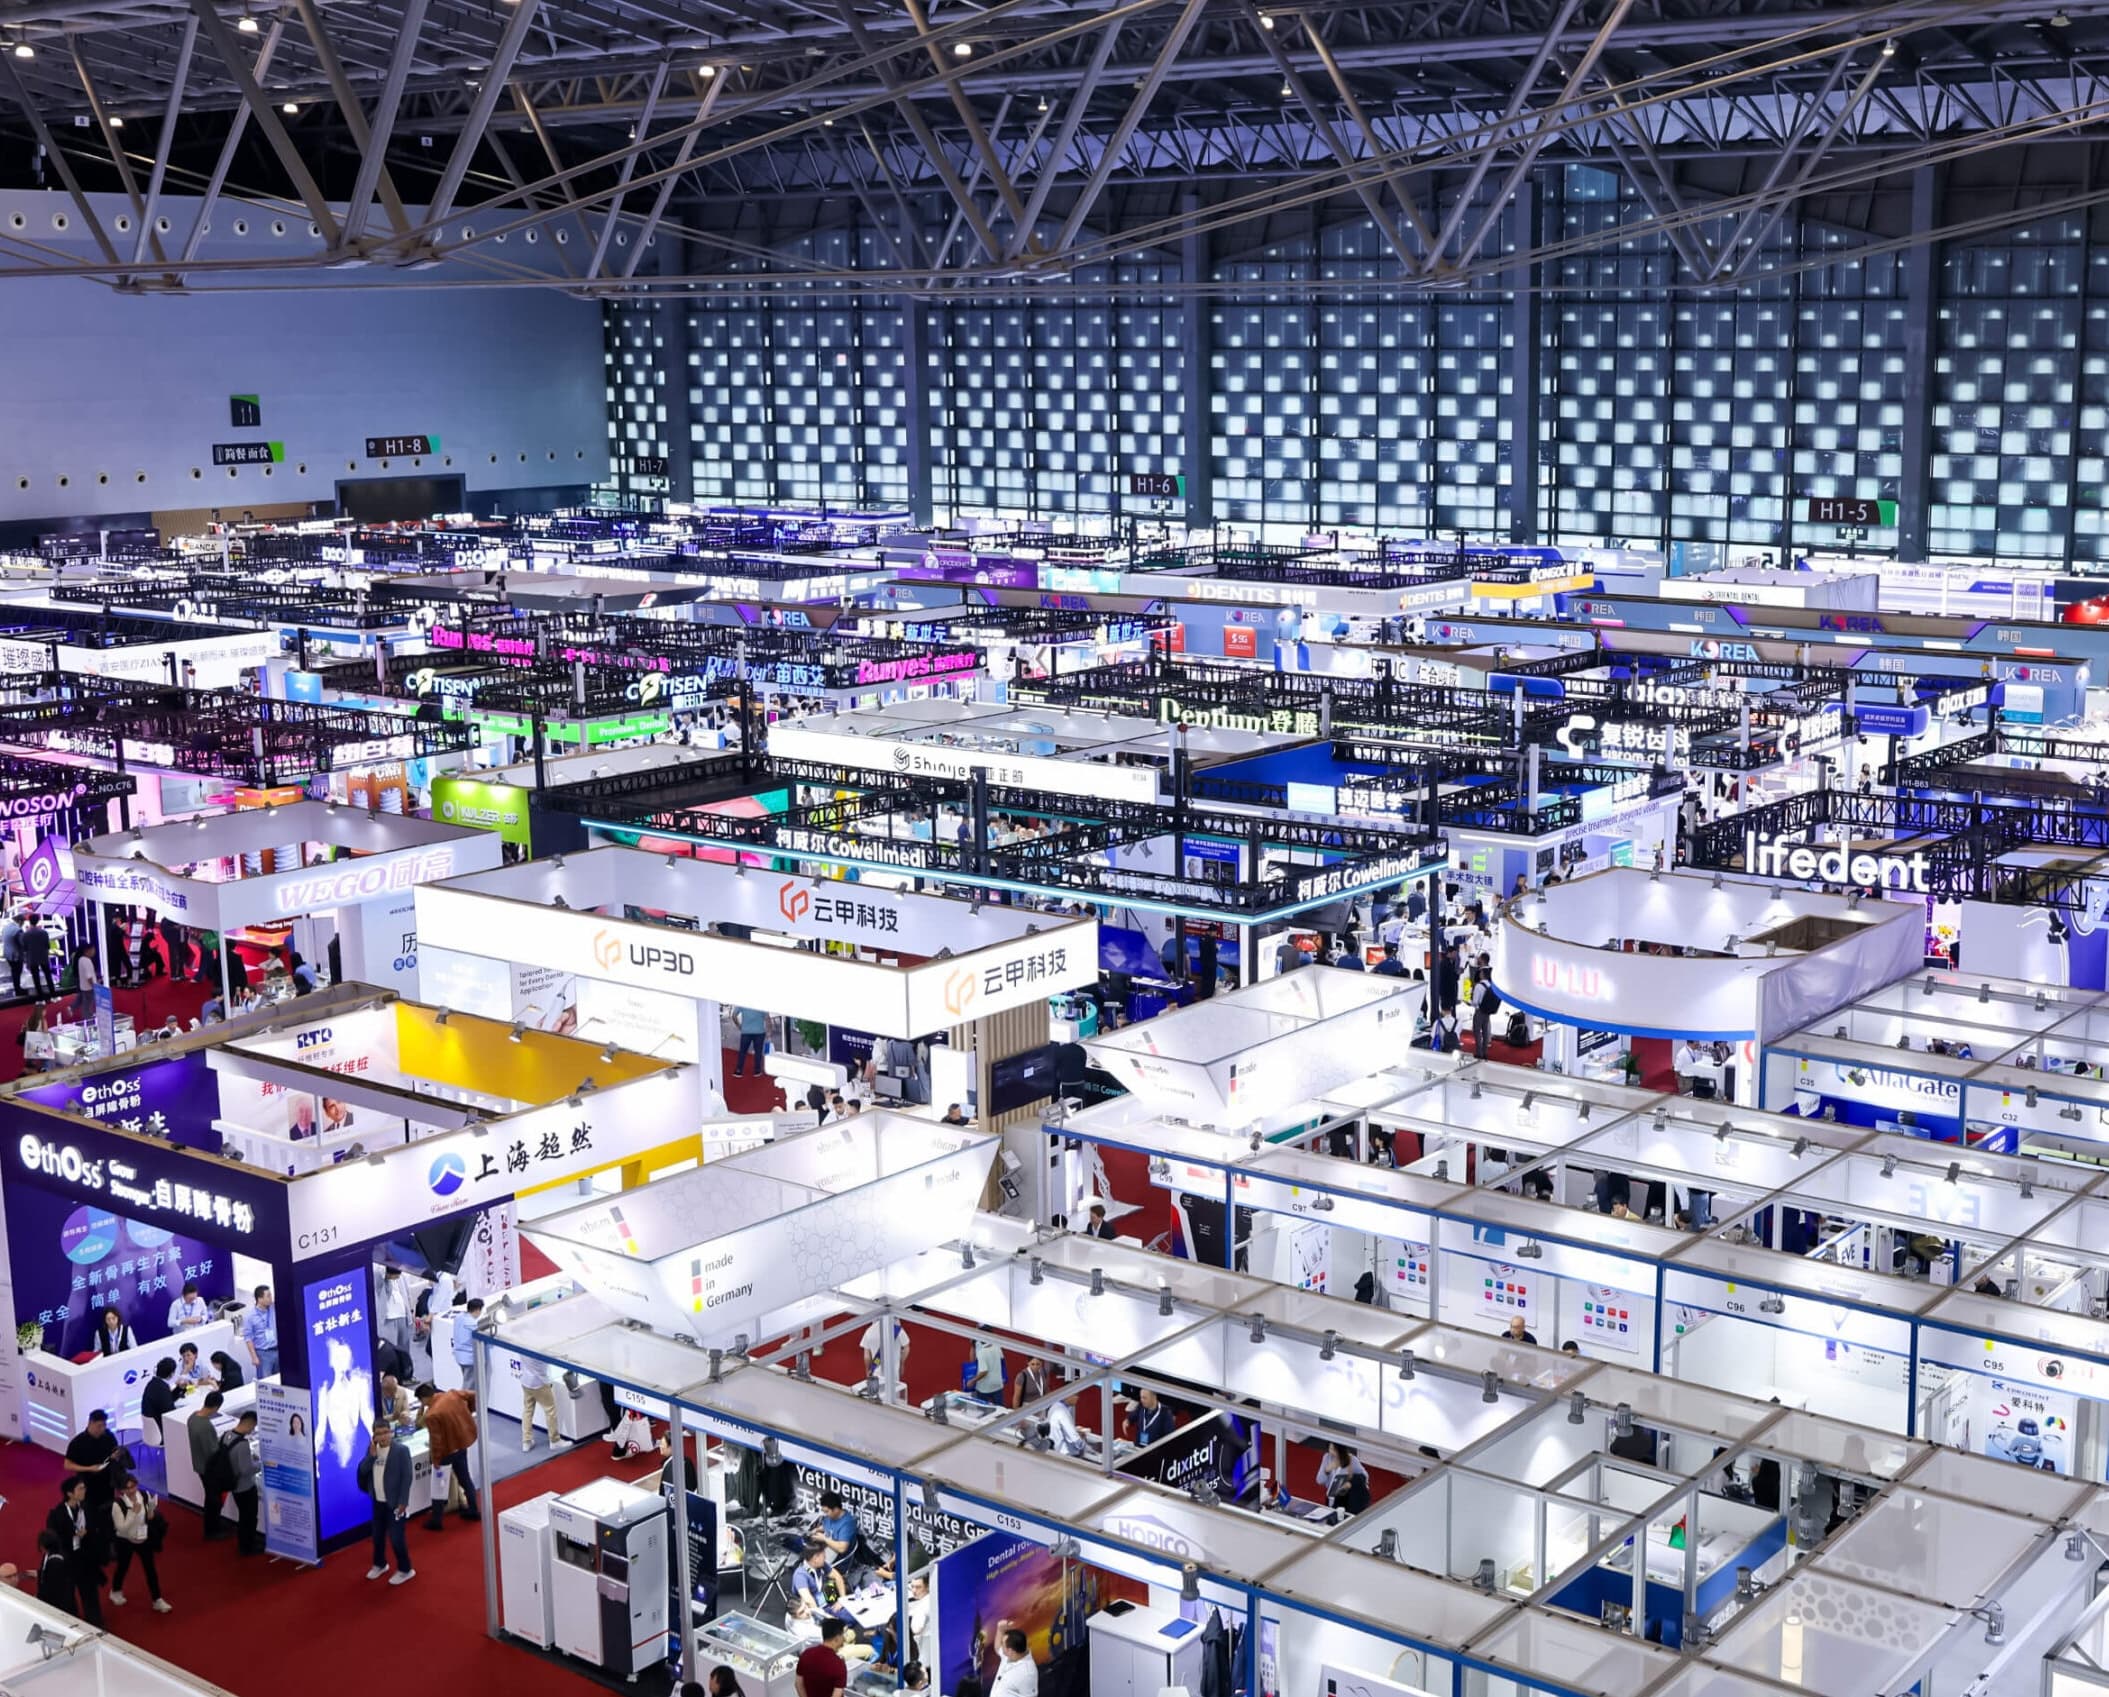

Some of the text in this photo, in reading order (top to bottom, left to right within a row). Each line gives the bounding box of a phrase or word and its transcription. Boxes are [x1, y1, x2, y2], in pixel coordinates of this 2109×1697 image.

[385, 437, 422, 455] H1-8
[639, 460, 663, 473] H1-7
[1137, 480, 1170, 495] H1-6
[1821, 504, 1868, 521] H1-5
[1040, 595, 1090, 611] KOREA
[1204, 583, 1275, 602] DENTIS
[1226, 610, 1265, 623] KOREA
[1574, 601, 1616, 616] KOREA
[1431, 624, 1476, 640] KOREA
[1820, 614, 1884, 632] KOREA
[432, 625, 492, 650] Runes
[1690, 641, 1760, 662] KOREA
[858, 654, 930, 684] Runyes
[2005, 666, 2063, 683] KOREA
[99, 780, 132, 793] NO.C76
[1901, 778, 1929, 789] H1-B63
[776, 827, 927, 869] 柯威尔 Cowellmedi
[1746, 830, 1930, 891] lifedent
[280, 860, 386, 911] WEGO
[1298, 850, 1420, 901] 柯威尔 Cowellmedi
[1446, 870, 1494, 887] 手术放大镜
[814, 898, 899, 933] 云甲科技
[630, 943, 694, 976] UP3D
[984, 947, 1067, 996] 云甲科技
[297, 1027, 333, 1049] RTD
[82, 1078, 141, 1103] ethOss
[19, 1134, 104, 1190] ethOss
[474, 1122, 592, 1181] 上海超然
[154, 1178, 256, 1235] 自屏障骨粉
[298, 1225, 338, 1250] C131
[71, 1245, 183, 1292] 全新骨再生方案
[705, 1252, 734, 1273] made
[38, 1259, 214, 1327] 安全 简单 有效 友好
[705, 1276, 716, 1291] in
[706, 1281, 753, 1309] Germany
[1726, 1301, 1746, 1313] C96
[1983, 1360, 2005, 1371] C95
[1166, 1438, 1214, 1481] dixital
[795, 1463, 826, 1490] Yeti
[997, 1513, 1022, 1529] C153
[988, 1544, 1016, 1569] Dental
